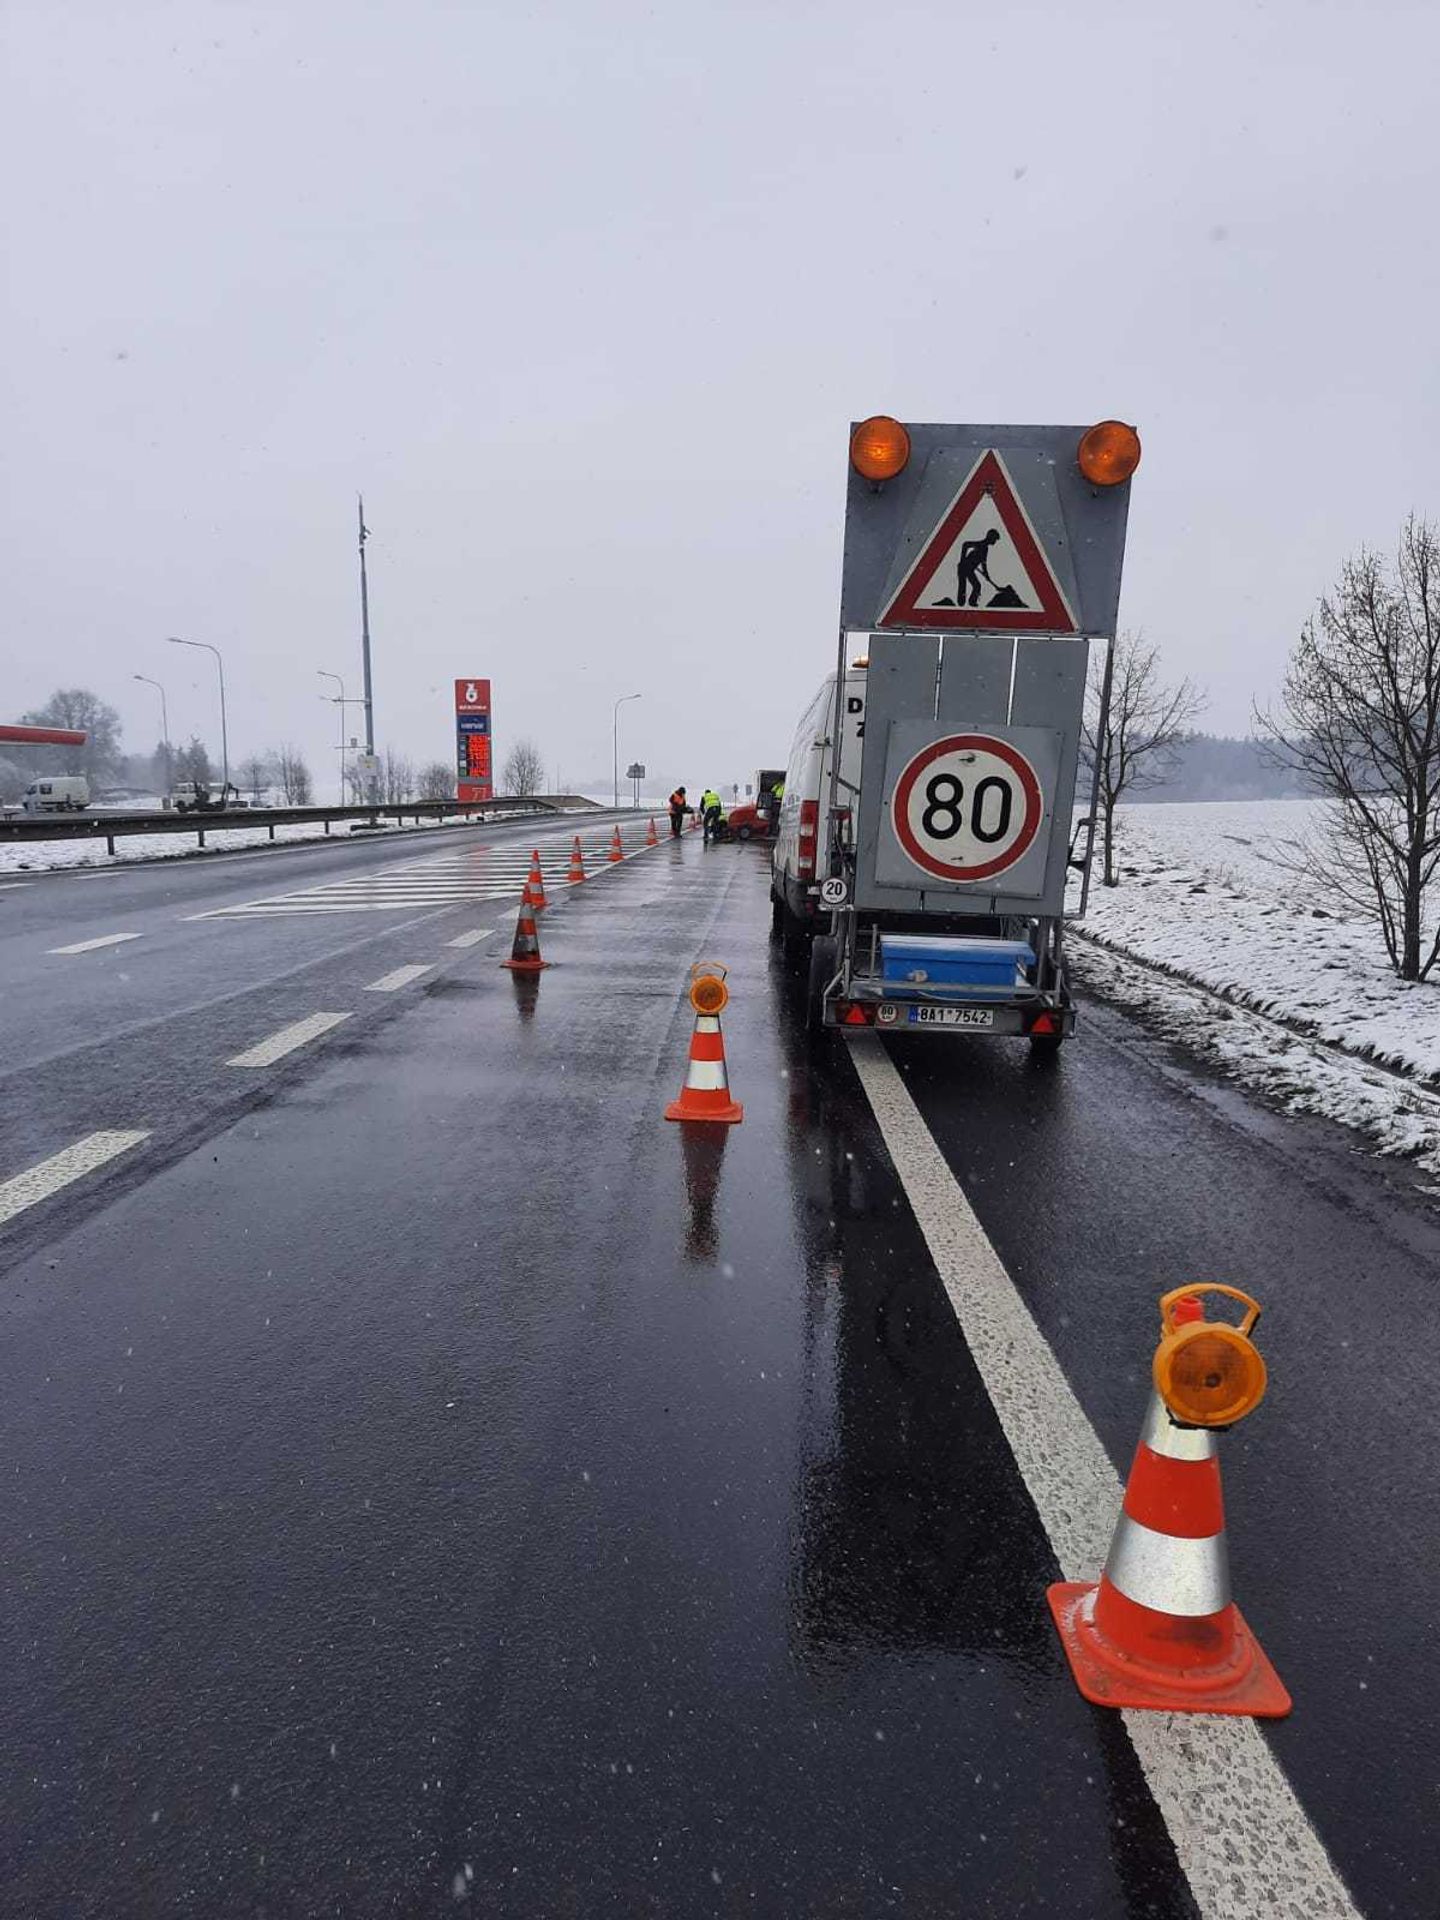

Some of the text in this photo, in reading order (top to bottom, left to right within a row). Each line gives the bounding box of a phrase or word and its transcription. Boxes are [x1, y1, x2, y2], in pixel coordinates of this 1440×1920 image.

[922, 773, 1012, 843] 80
[825, 881, 843, 896] 20
[920, 1007, 987, 1024] 8A1 7542
